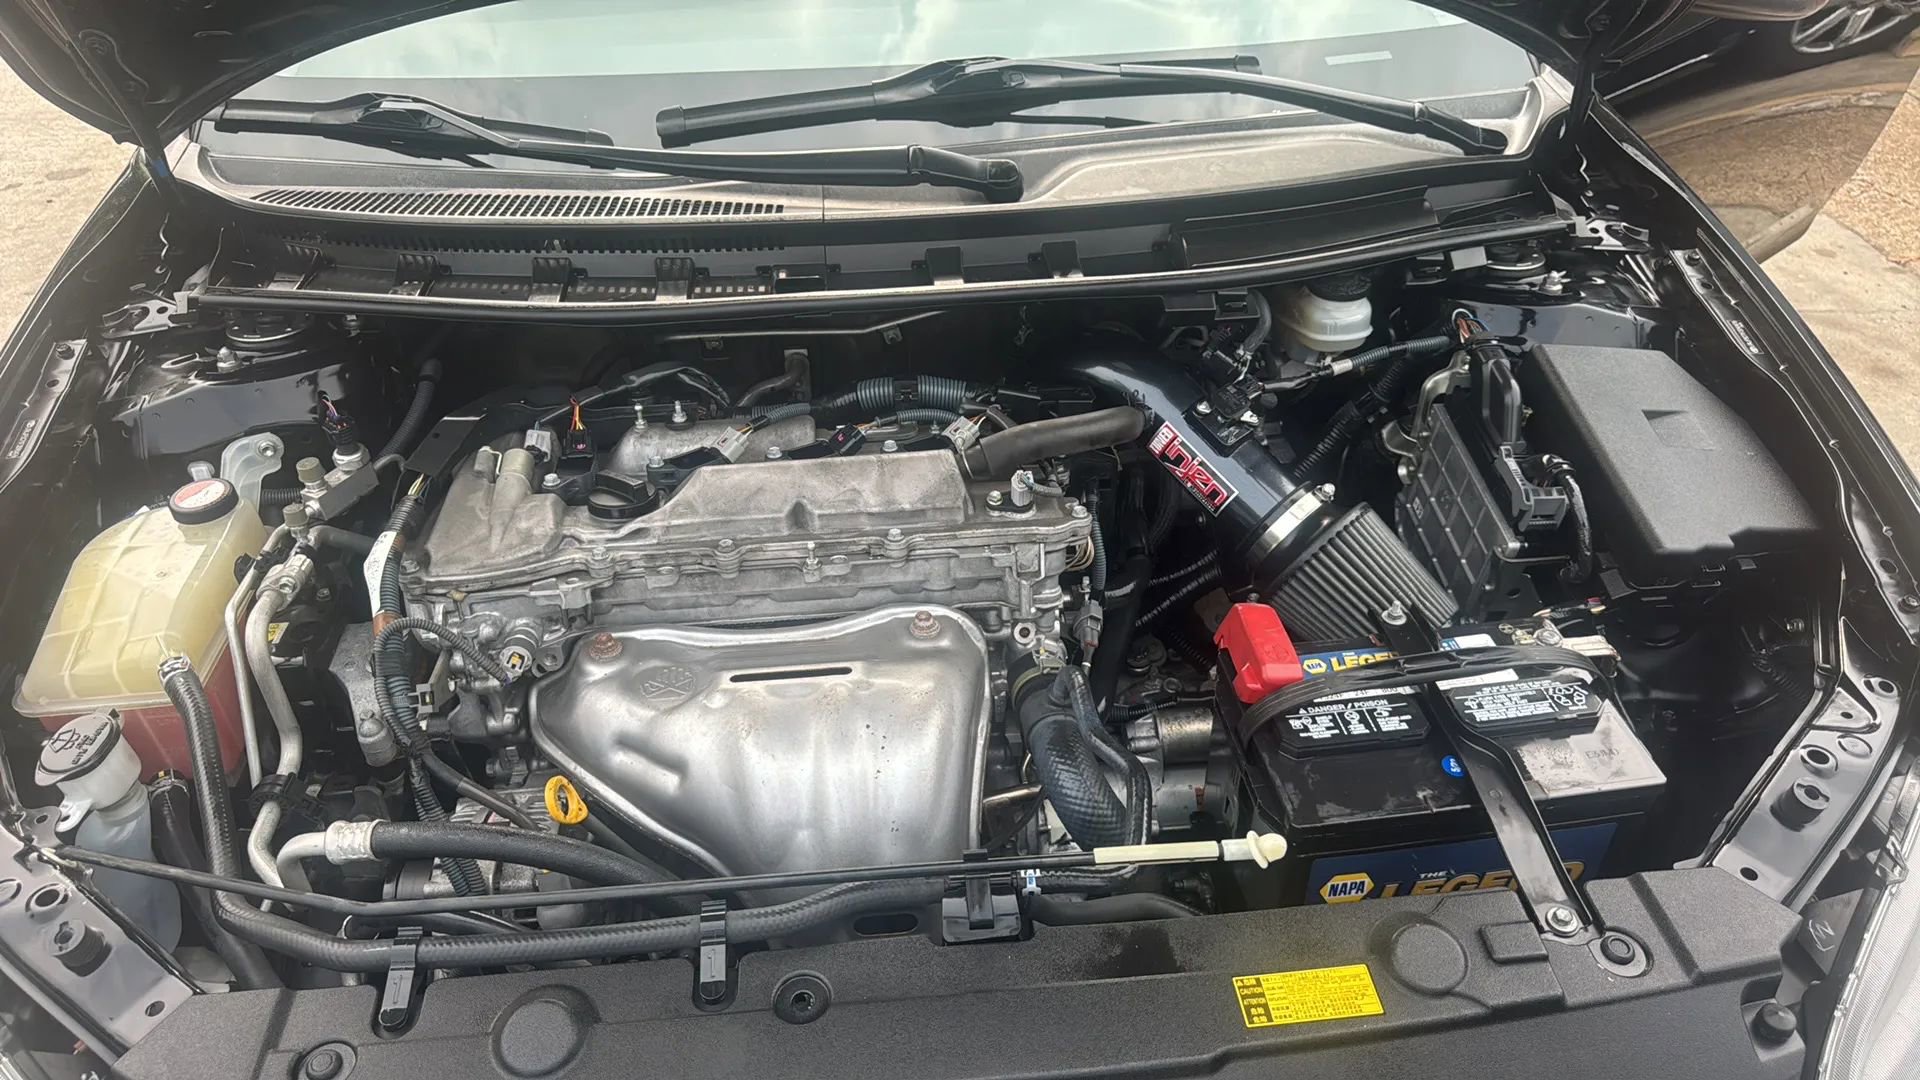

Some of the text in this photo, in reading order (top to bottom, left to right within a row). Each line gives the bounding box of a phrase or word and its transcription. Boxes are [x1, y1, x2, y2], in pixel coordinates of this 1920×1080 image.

[1165, 437, 1227, 506] injen
[1329, 651, 1400, 672] LEGE
[1308, 703, 1346, 714] DANGER
[1353, 699, 1389, 708] POISON
[1419, 870, 1447, 879] THE
[1328, 880, 1366, 898] NAPA
